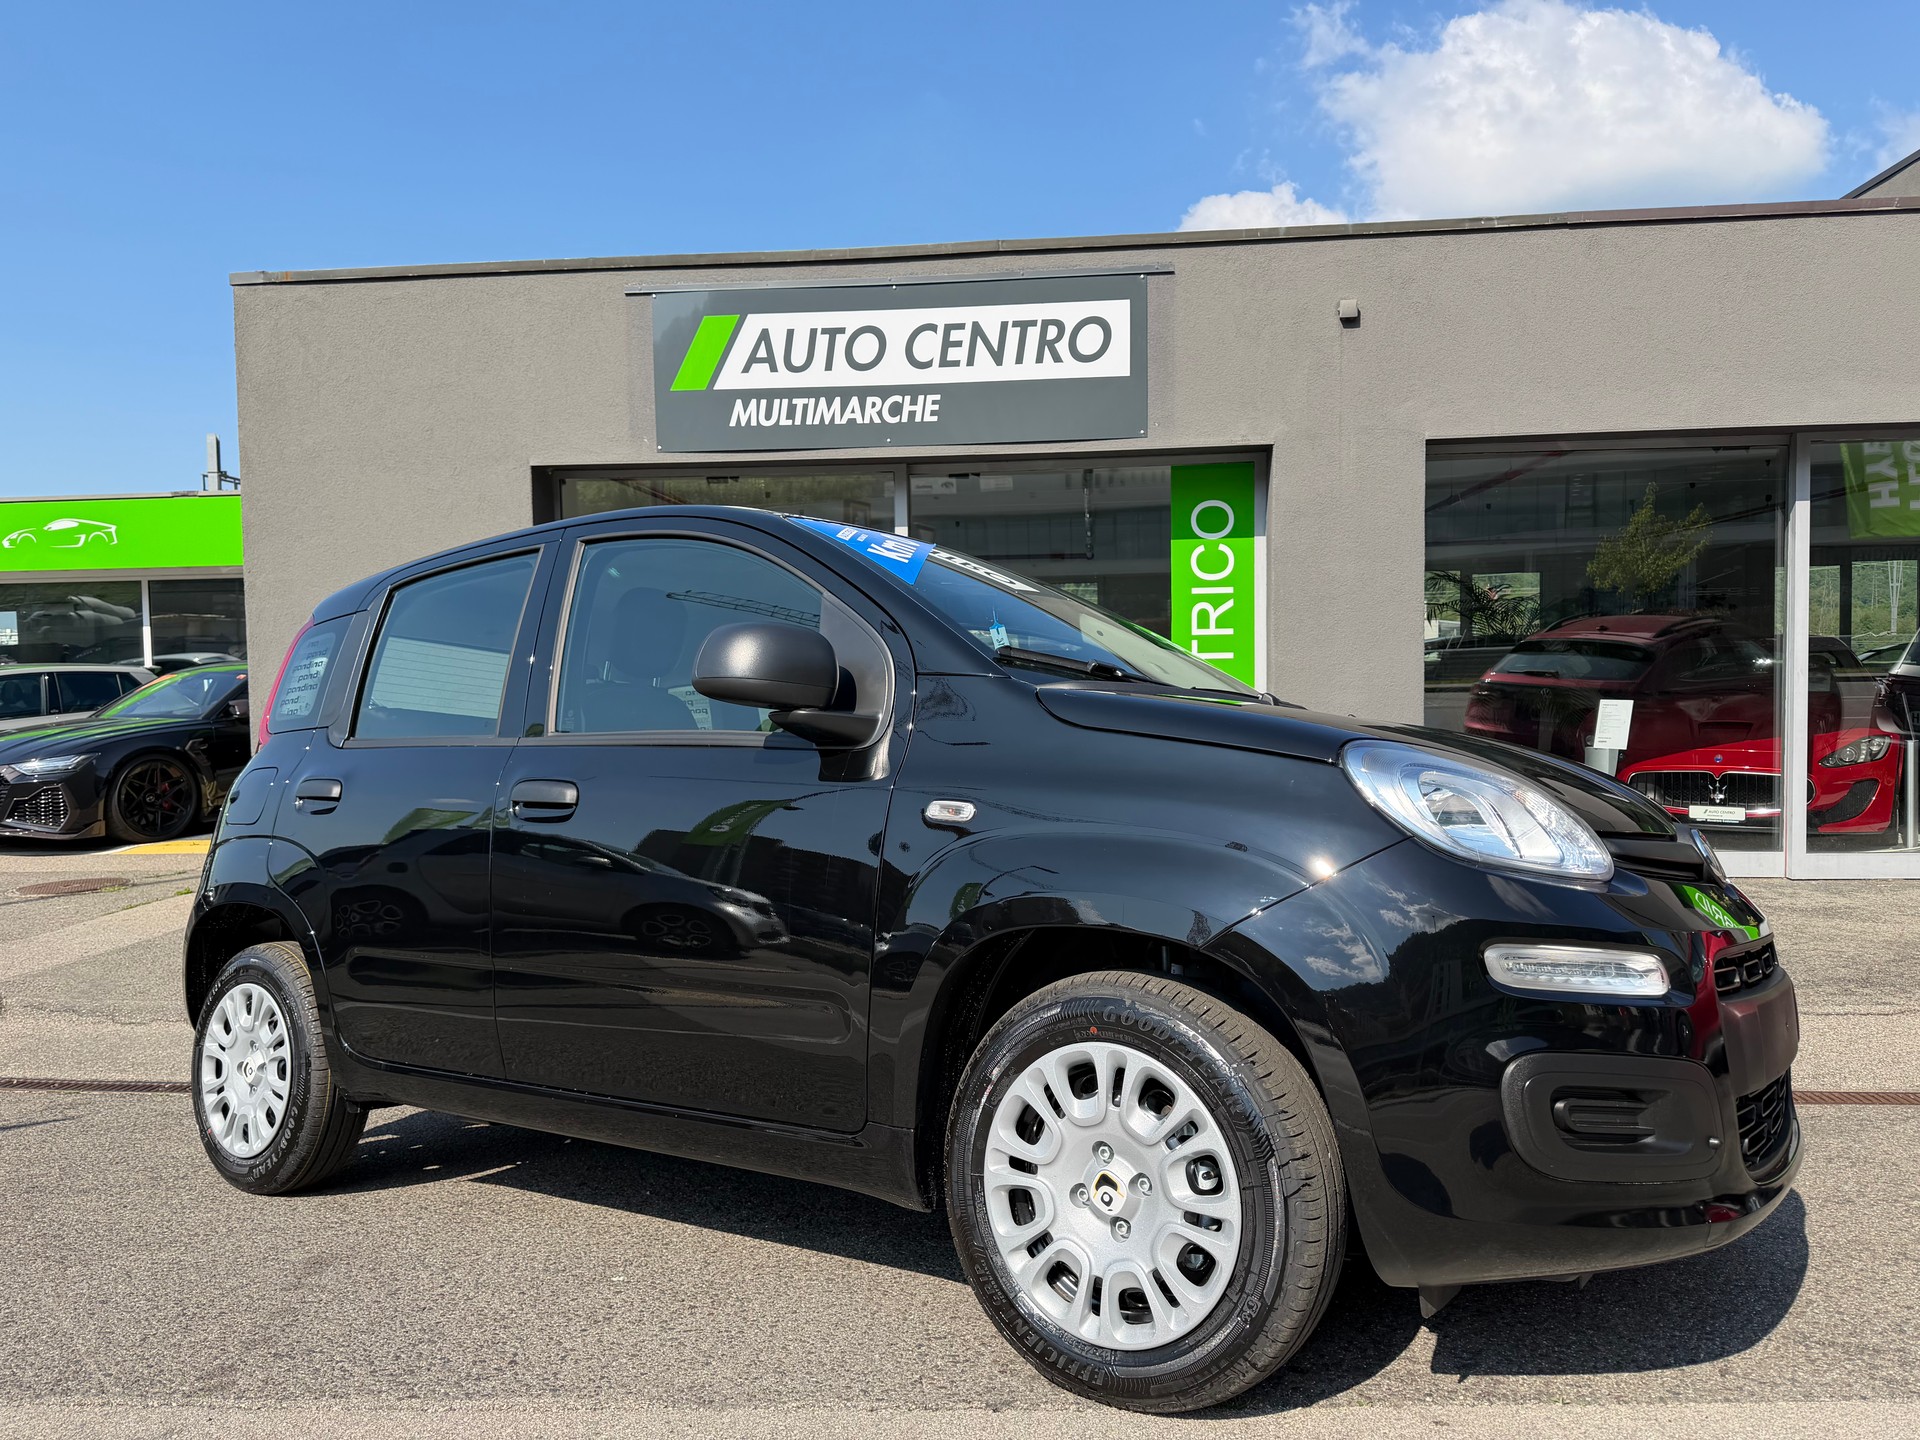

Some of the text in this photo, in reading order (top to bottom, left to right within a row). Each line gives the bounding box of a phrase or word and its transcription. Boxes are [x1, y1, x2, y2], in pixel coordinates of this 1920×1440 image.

[741, 315, 1112, 374] AUTO CENTRO
[729, 394, 941, 427] MULTIMARCHE
